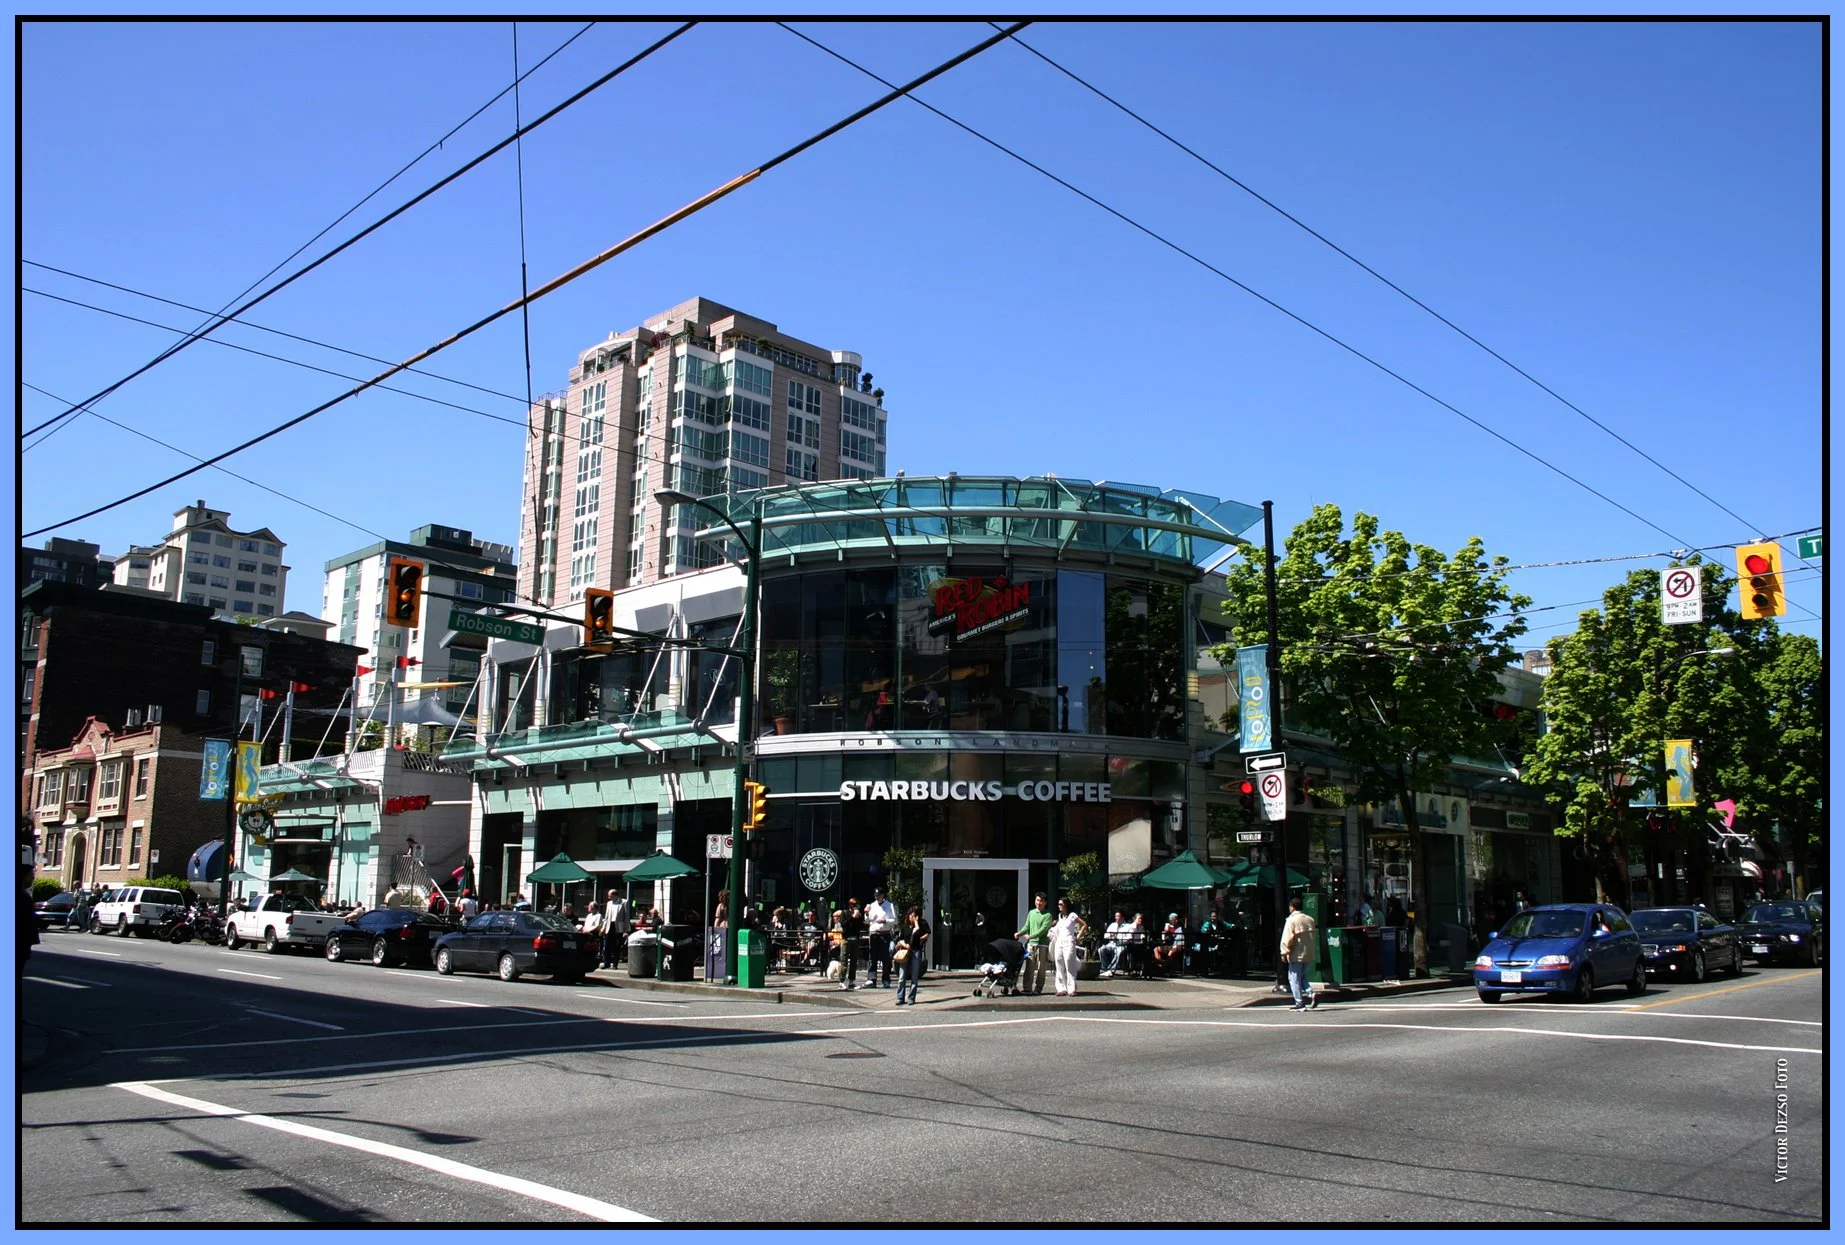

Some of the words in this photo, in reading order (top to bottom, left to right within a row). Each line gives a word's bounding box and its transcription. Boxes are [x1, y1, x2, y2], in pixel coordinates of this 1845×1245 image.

[935, 577, 983, 617] RED
[955, 581, 1029, 634] ROBIN
[456, 614, 512, 636] Robson
[520, 625, 537, 640] St
[981, 617, 1004, 631] BURGERS
[1009, 607, 1029, 621] SPIRITS
[840, 738, 942, 747] ROBSON
[840, 780, 1003, 801] STARBUCKS
[1017, 780, 1112, 802] COFFEE
[802, 850, 836, 868] STARBUCKS
[805, 878, 831, 889] COFFEE
